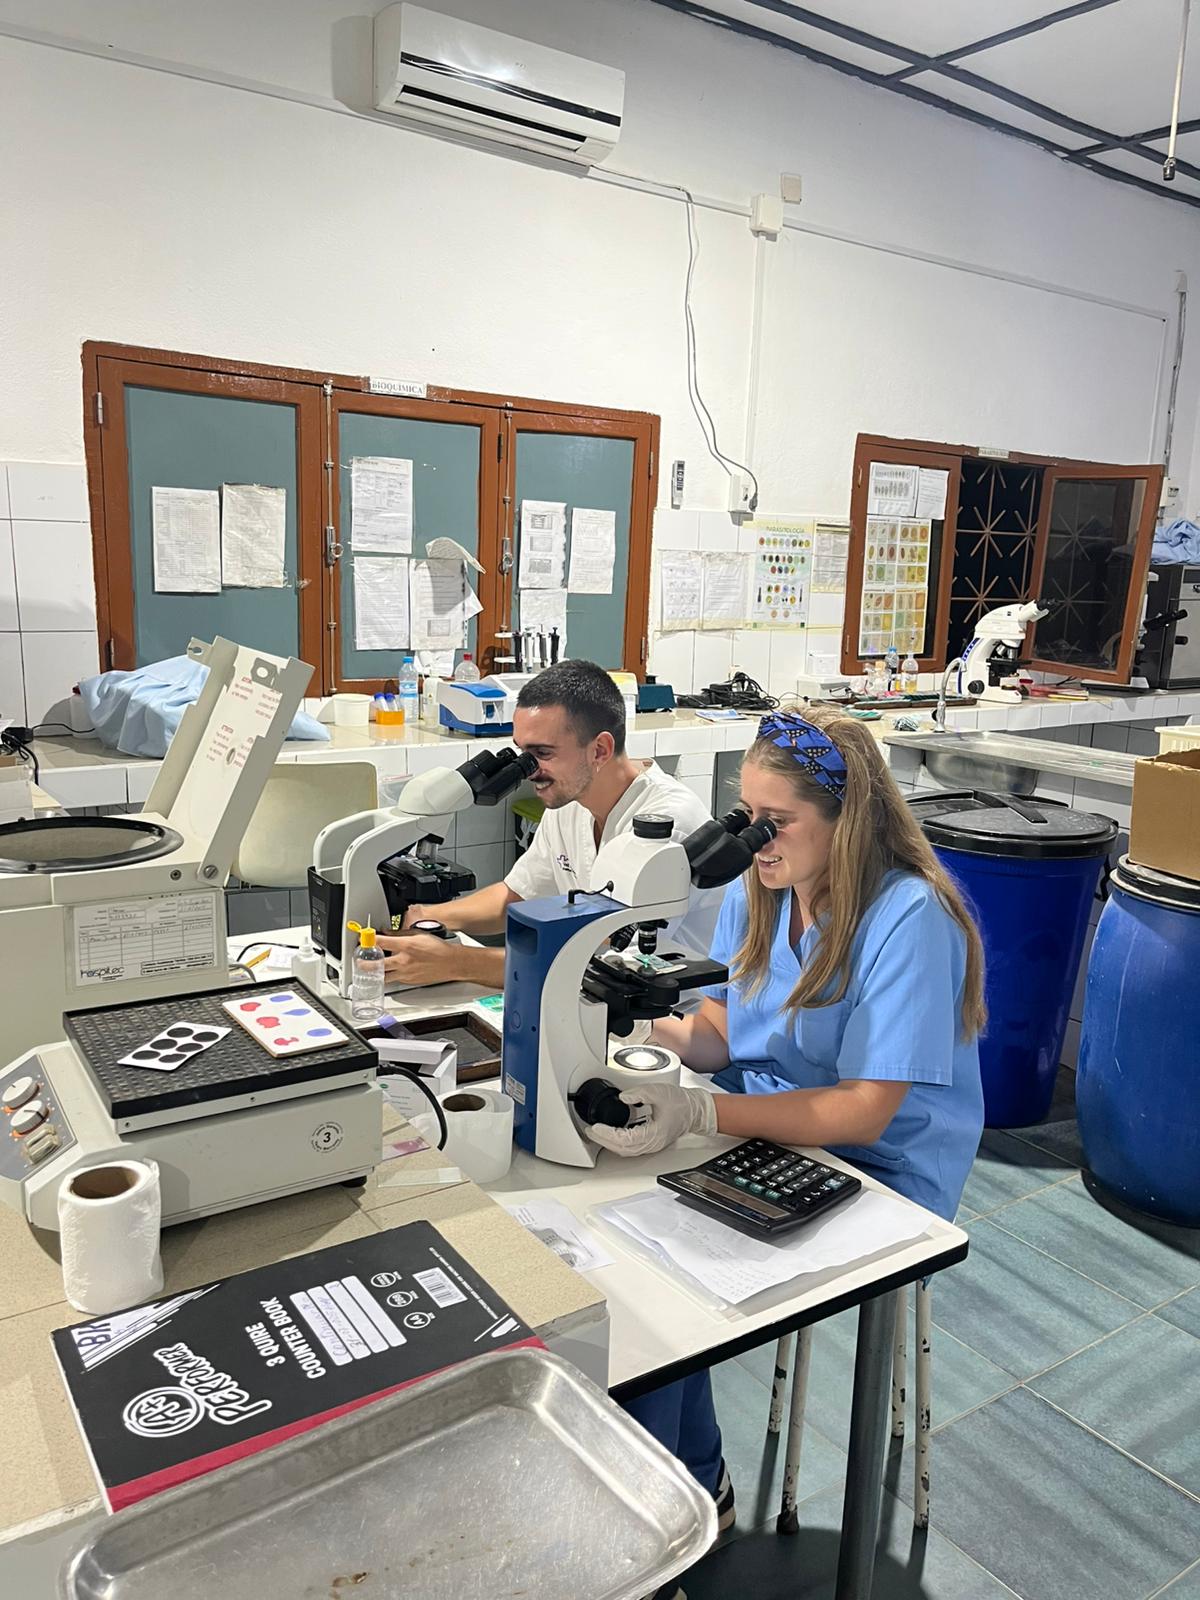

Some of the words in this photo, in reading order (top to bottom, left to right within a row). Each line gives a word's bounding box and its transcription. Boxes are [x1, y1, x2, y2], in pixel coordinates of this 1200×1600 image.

[323, 1131, 331, 1143] 3
[260, 1296, 293, 1327] BOOK
[409, 1314, 426, 1325] A4
[245, 1321, 280, 1357] QUIRE
[279, 1323, 326, 1379] COUNTER
[266, 1355, 286, 1367] 3
[153, 1342, 272, 1425] PERFORMER
